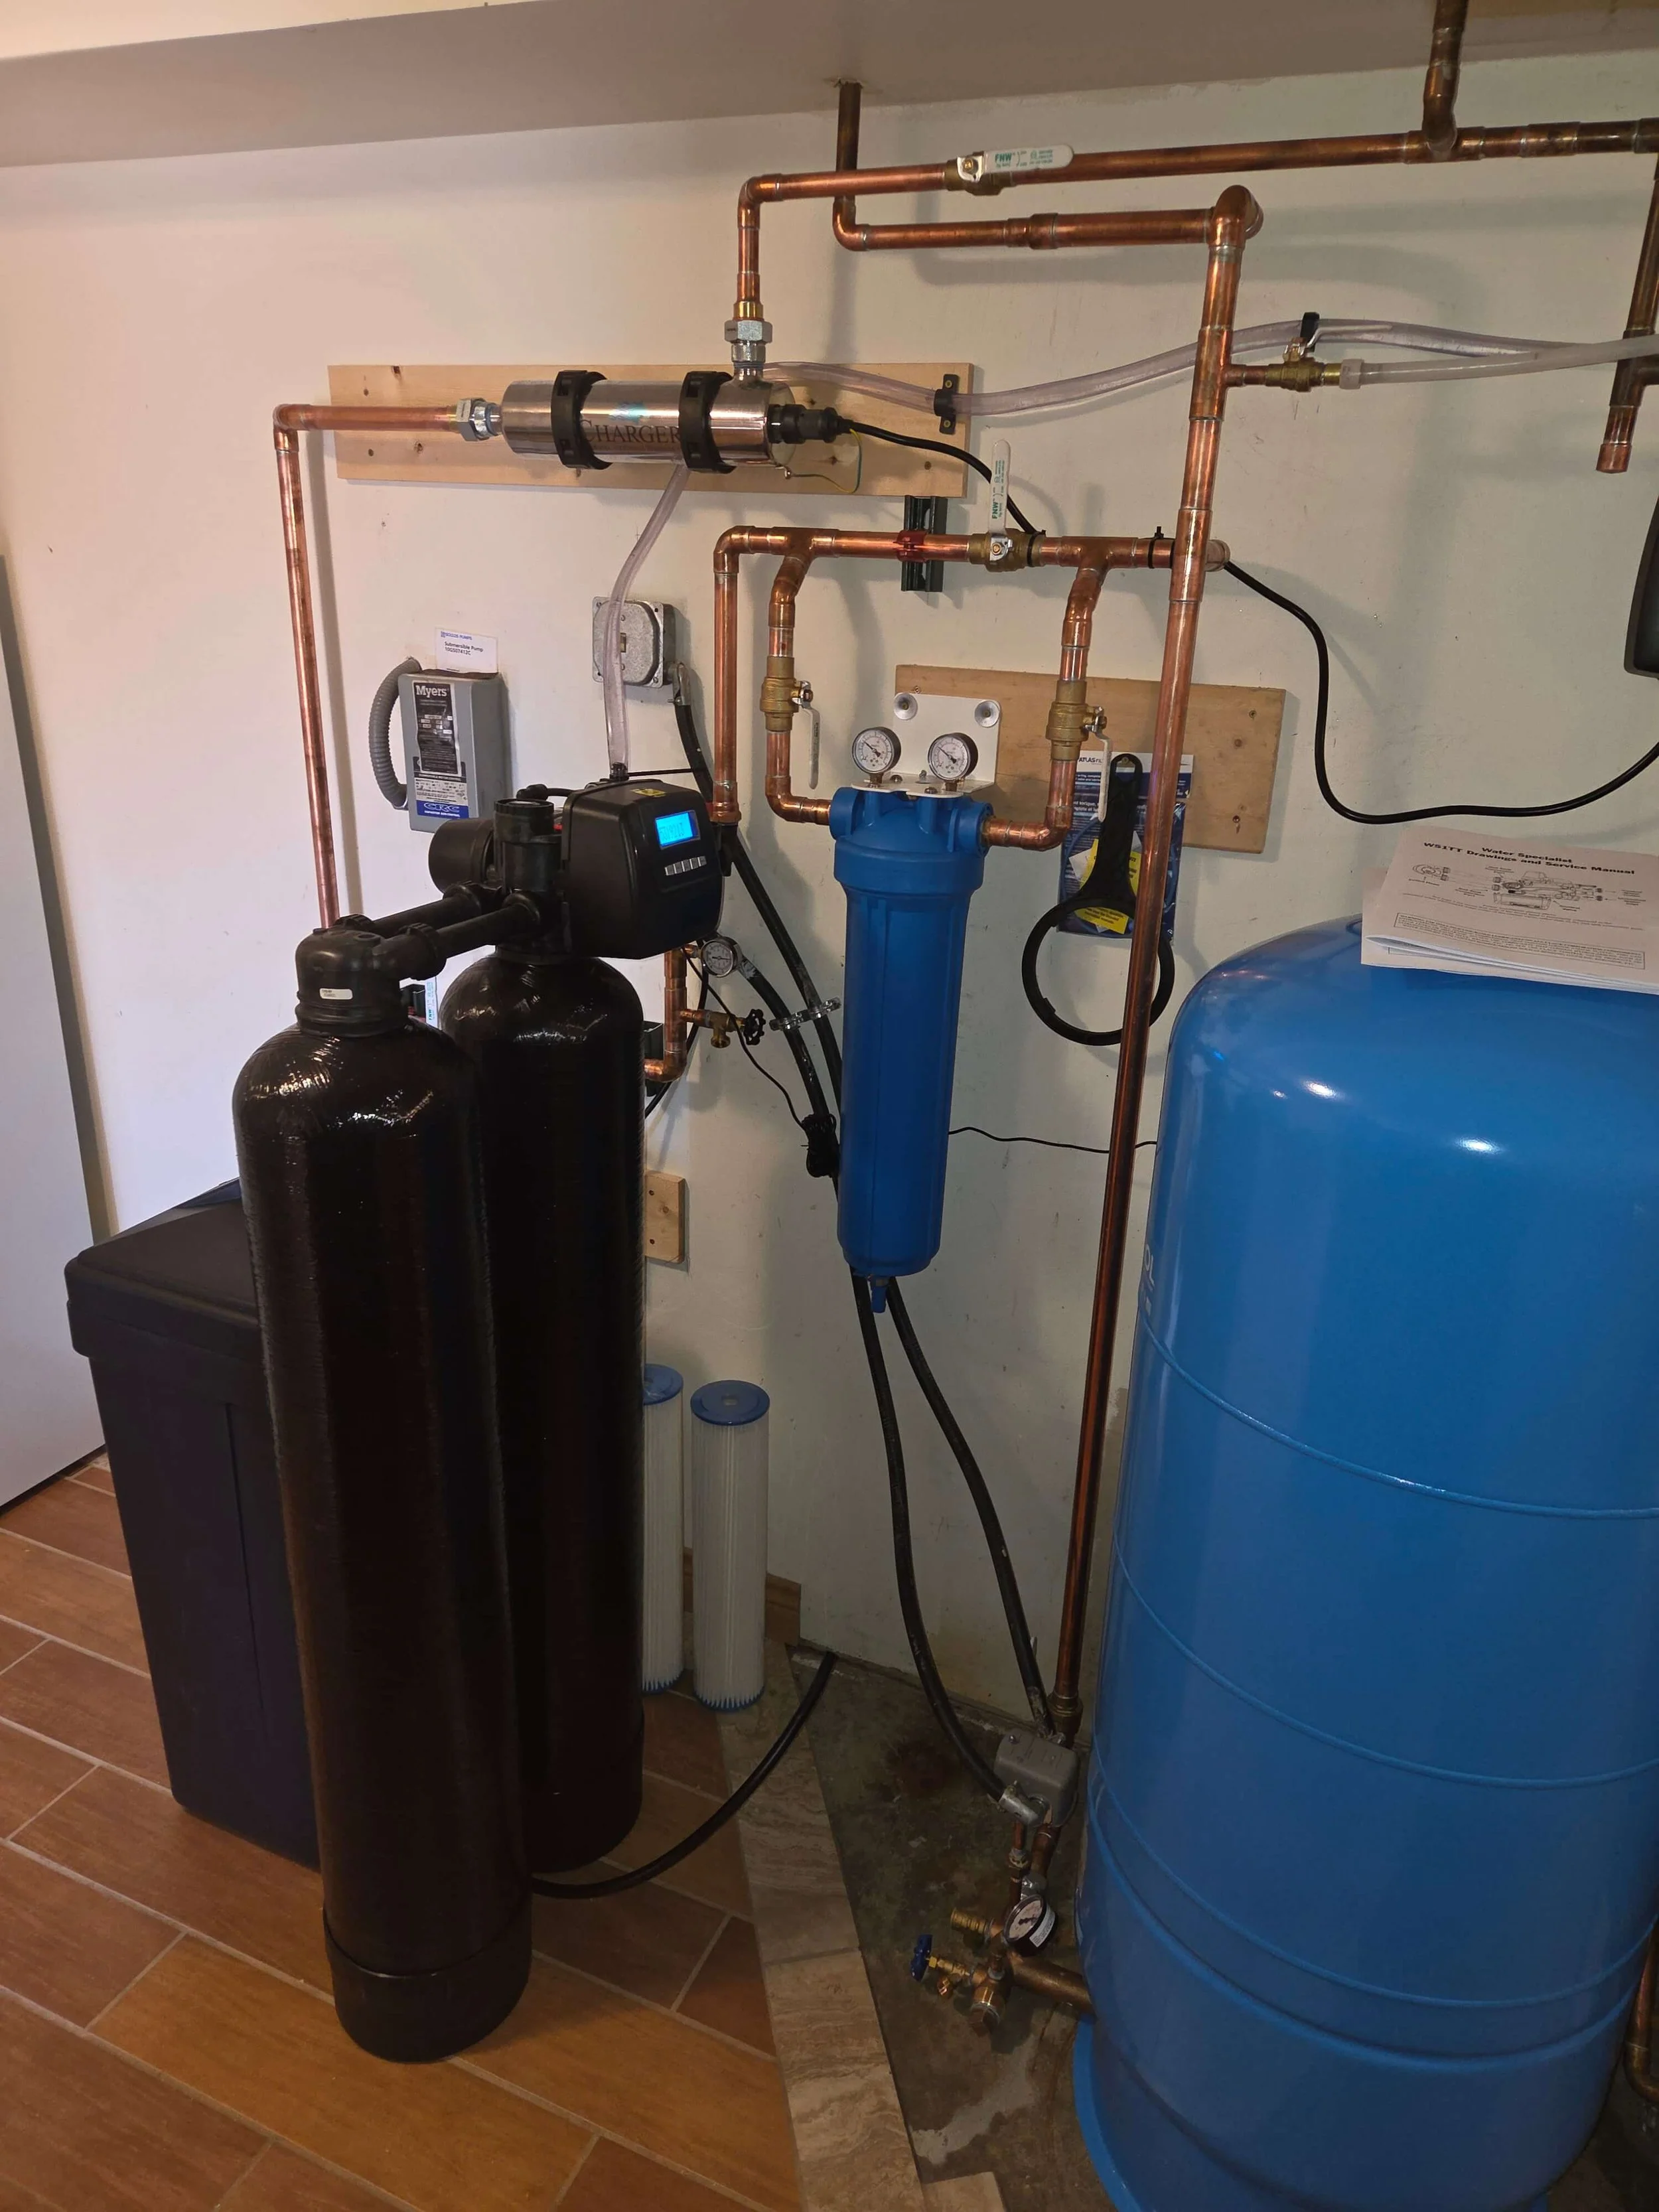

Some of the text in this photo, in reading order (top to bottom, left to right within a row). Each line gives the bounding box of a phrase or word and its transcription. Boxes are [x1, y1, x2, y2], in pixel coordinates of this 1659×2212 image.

[995, 152, 1012, 163] FNW
[444, 641, 470, 650] Submersible
[415, 685, 447, 698] Myers
[423, 802, 460, 813] CRC
[1482, 847, 1572, 863] Water Specialist
[1466, 850, 1518, 862] Drawings
[1544, 861, 1587, 871] Service
[1591, 866, 1635, 875] Manual
